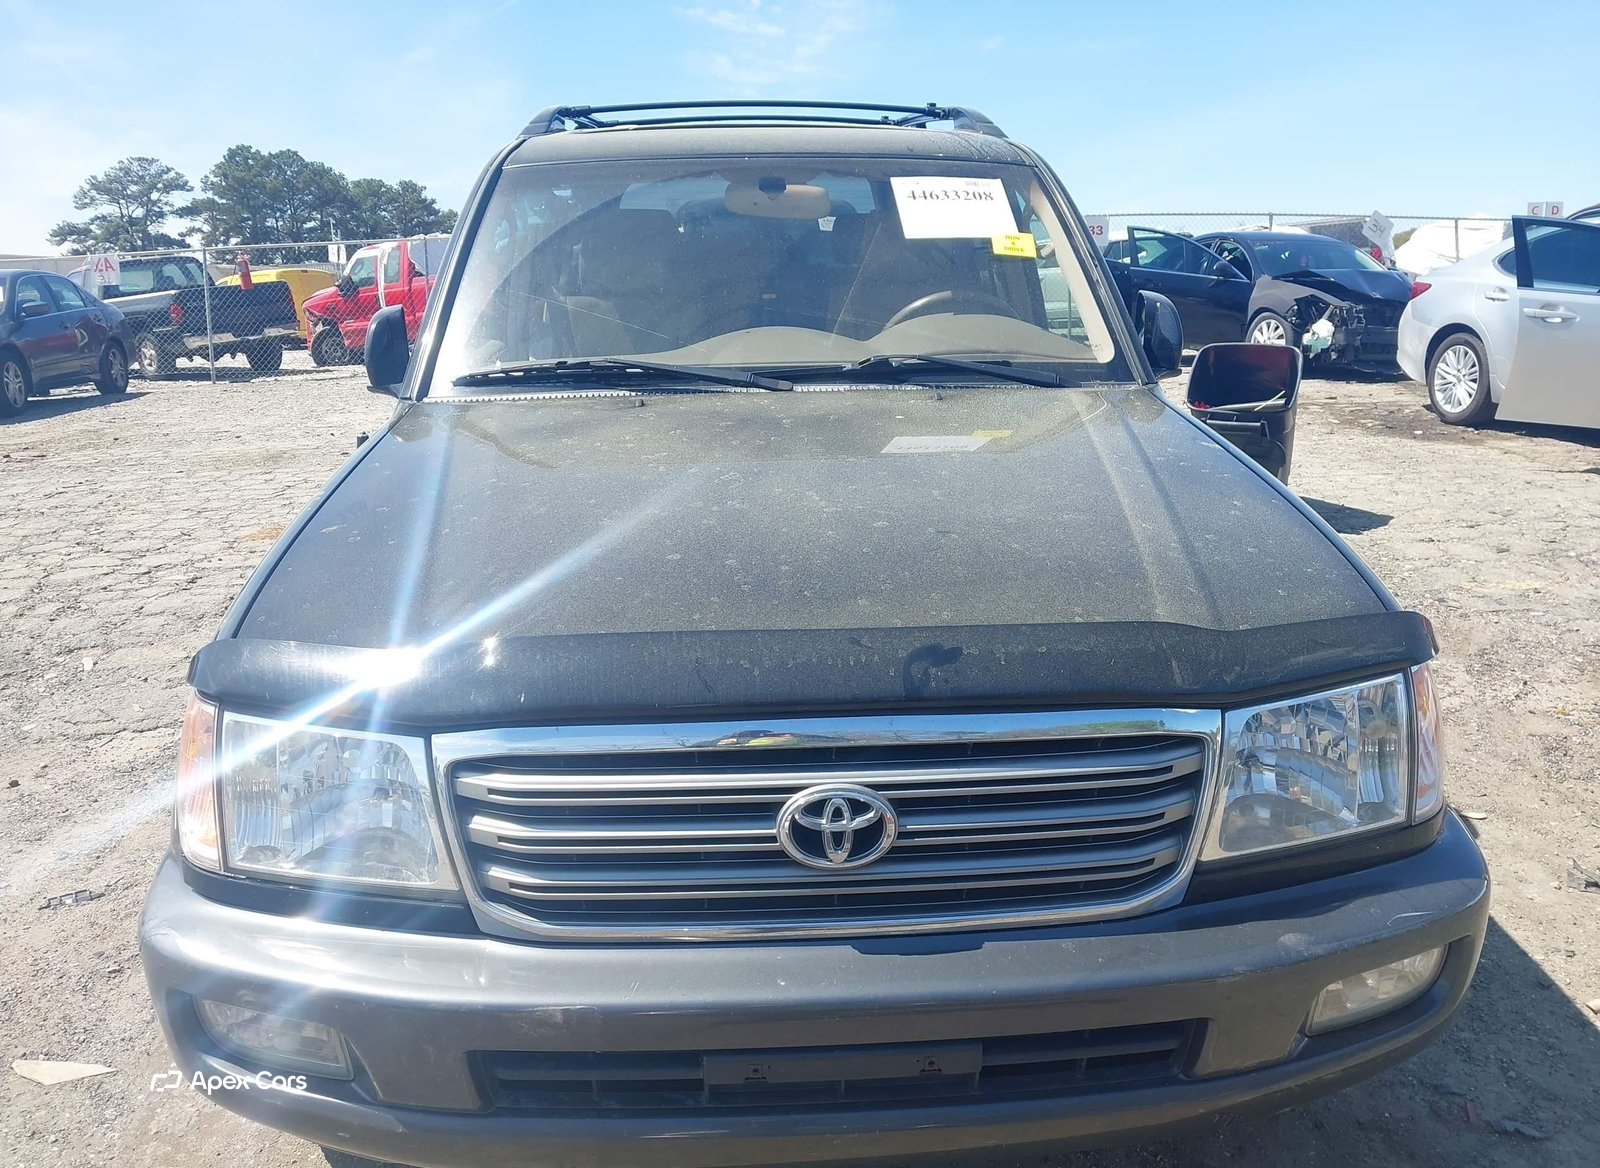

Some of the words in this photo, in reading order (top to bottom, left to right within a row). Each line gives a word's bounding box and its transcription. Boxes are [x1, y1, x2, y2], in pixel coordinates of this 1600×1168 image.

[907, 189, 994, 201] 44633208
[1532, 206, 1540, 215] C
[1552, 205, 1560, 215] D
